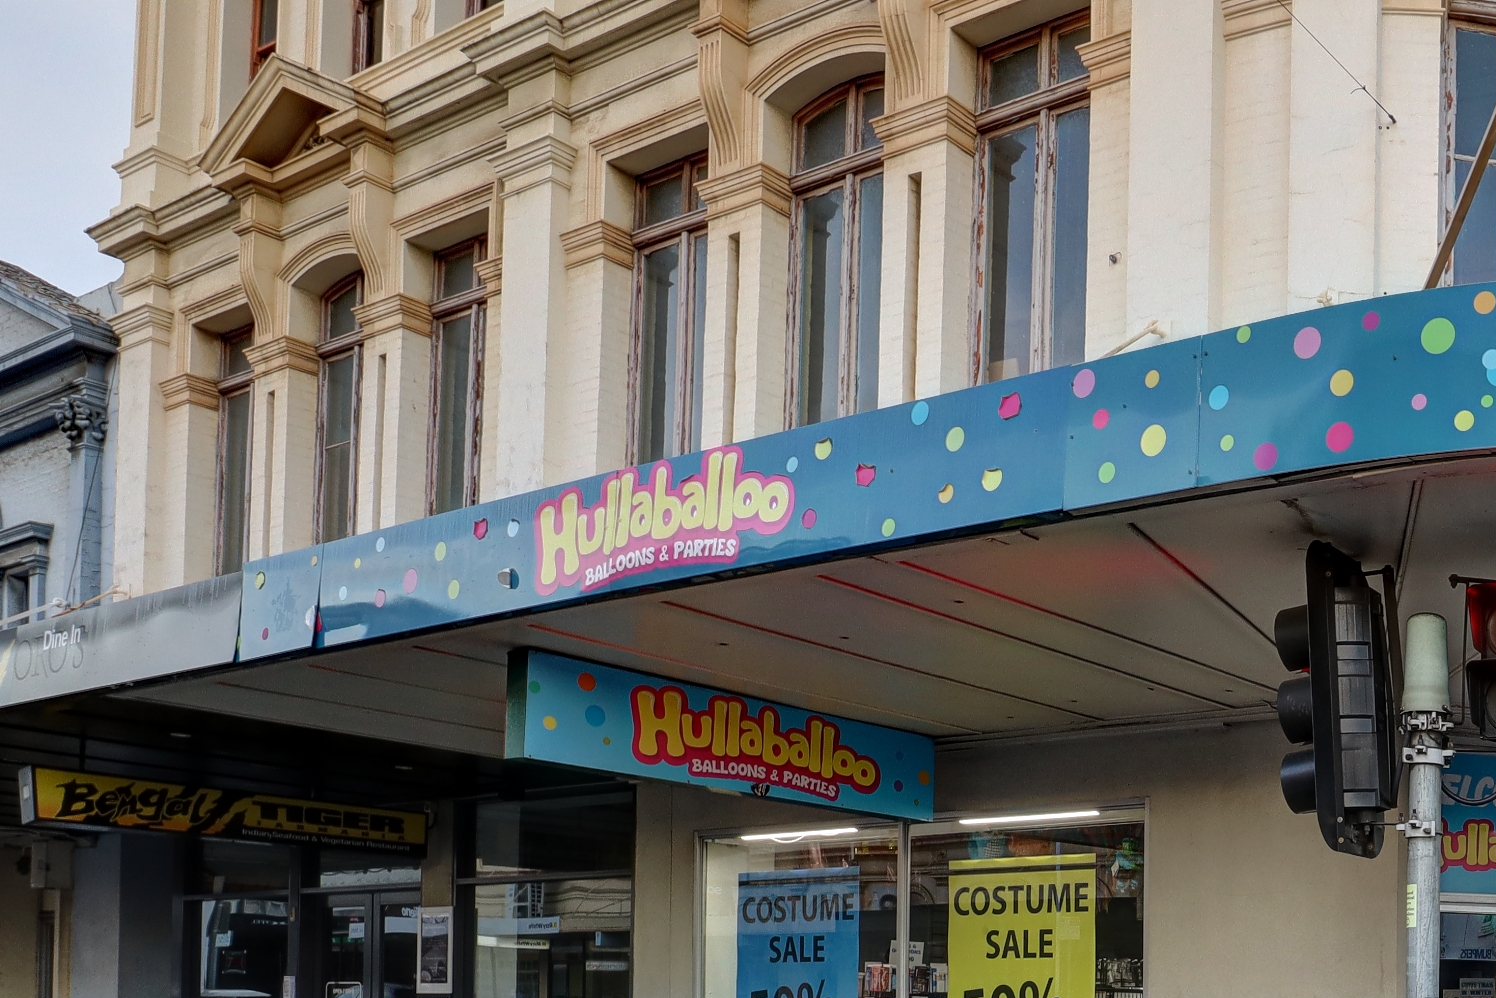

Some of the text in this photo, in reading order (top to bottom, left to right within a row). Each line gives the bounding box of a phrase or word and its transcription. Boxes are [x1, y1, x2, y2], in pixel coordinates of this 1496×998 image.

[540, 450, 789, 585] Hullaballoo
[585, 537, 737, 586] BALLOONS & PARTIES
[43, 624, 81, 650] Dine In
[637, 690, 876, 786] Hullaballoo
[691, 758, 837, 797] BALLOONS & PARTIES
[55, 779, 210, 826] Bengal
[252, 800, 405, 835] TIGER
[256, 820, 406, 841] TASMANIA
[320, 836, 365, 848] Vegetarian
[366, 841, 410, 851] Restaurant
[742, 892, 855, 924] COSTUME
[953, 882, 1089, 916] COSTUME
[769, 935, 826, 963] SALE
[986, 928, 1054, 959] SALE
